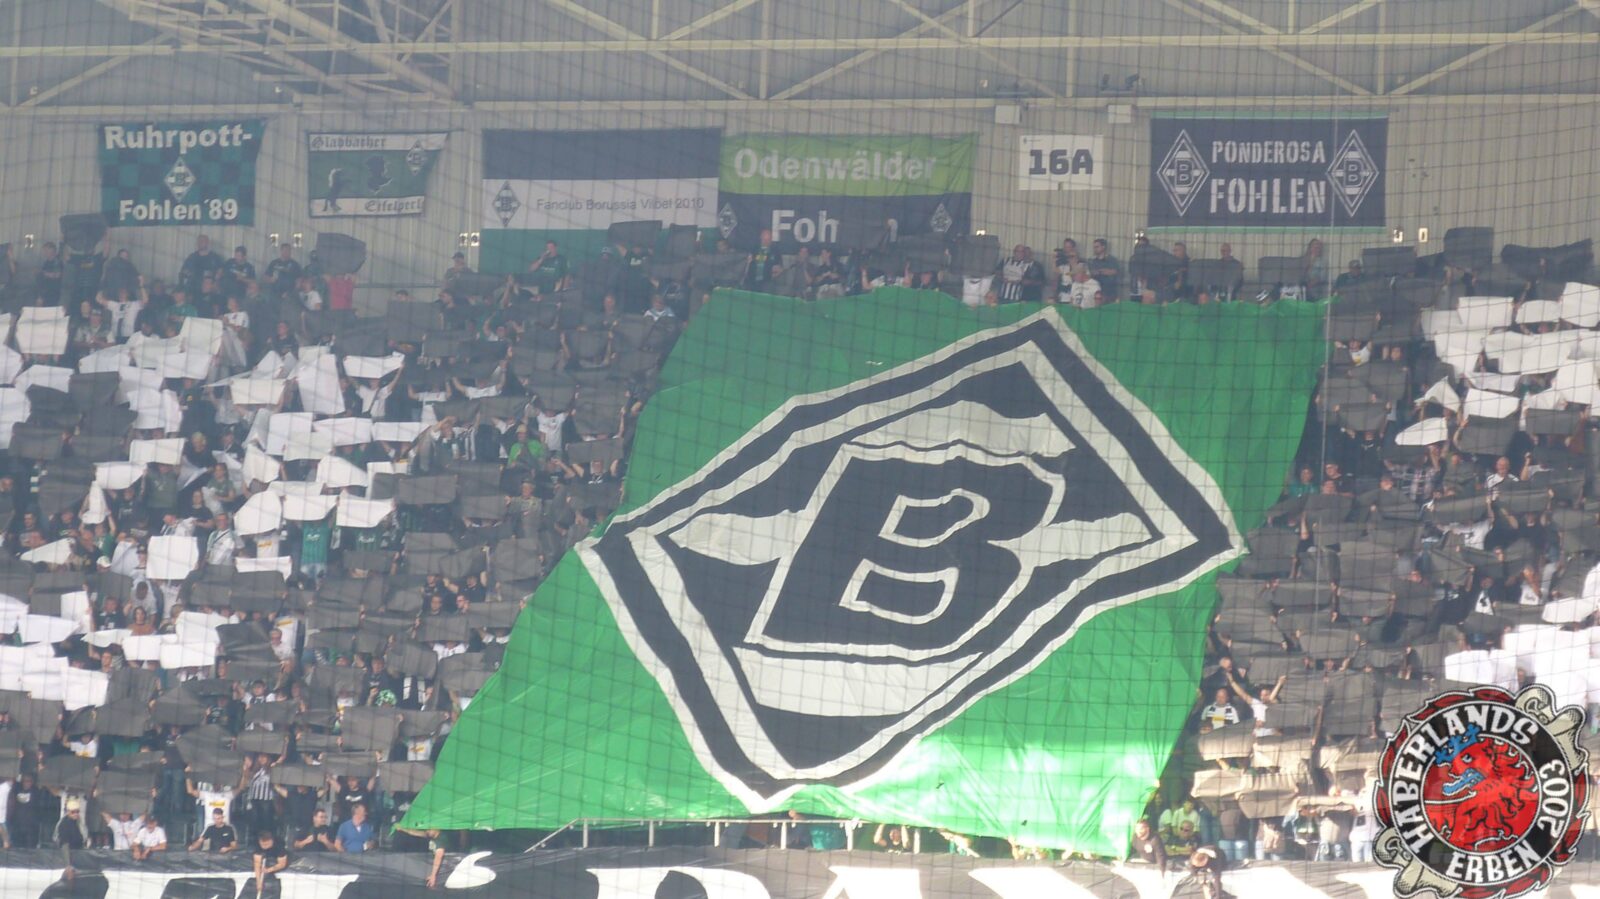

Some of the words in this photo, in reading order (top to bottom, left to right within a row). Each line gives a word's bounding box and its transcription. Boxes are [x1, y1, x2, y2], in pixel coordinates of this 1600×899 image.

[104, 124, 252, 154] Ruhrpott-
[1029, 149, 1093, 175] 16A
[1212, 140, 1326, 163] PONDEROSA
[735, 148, 937, 180] Odenwälder
[364, 198, 424, 212] Eifelperl
[537, 199, 583, 211] Fanclub
[586, 199, 637, 211] Borussia
[675, 197, 704, 209] 2010
[1210, 178, 1326, 214] FOHLEN
[120, 199, 201, 221] Fohlen
